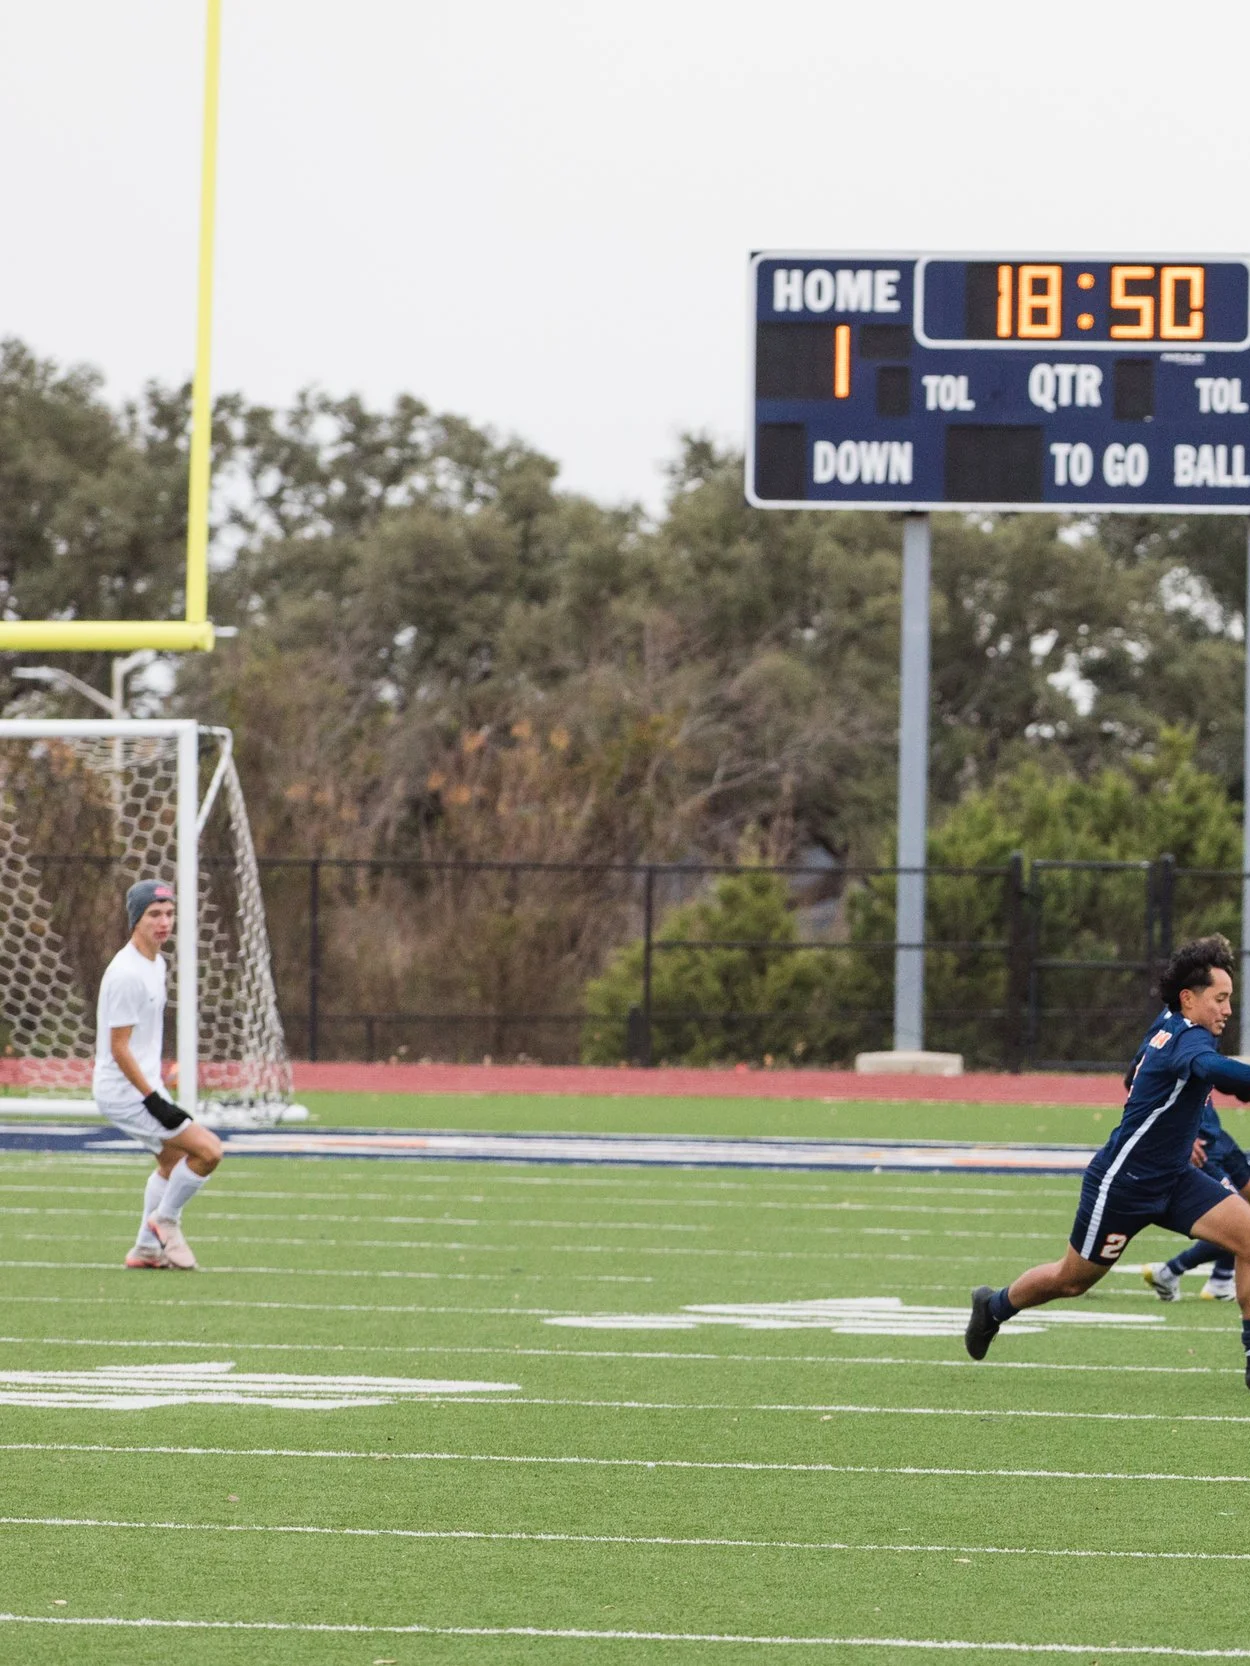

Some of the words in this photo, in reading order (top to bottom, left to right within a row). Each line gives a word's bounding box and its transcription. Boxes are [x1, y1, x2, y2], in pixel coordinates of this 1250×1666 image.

[773, 269, 901, 313] HOME
[996, 265, 1205, 340] 18:50
[834, 324, 850, 399] 1
[921, 375, 976, 411] TOL
[1028, 363, 1103, 412] QTR
[1194, 377, 1249, 413] TOL
[813, 440, 913, 485] DOWN
[1050, 442, 1094, 487] TO
[1103, 443, 1149, 487] GO
[1100, 1233, 1127, 1259] 2
